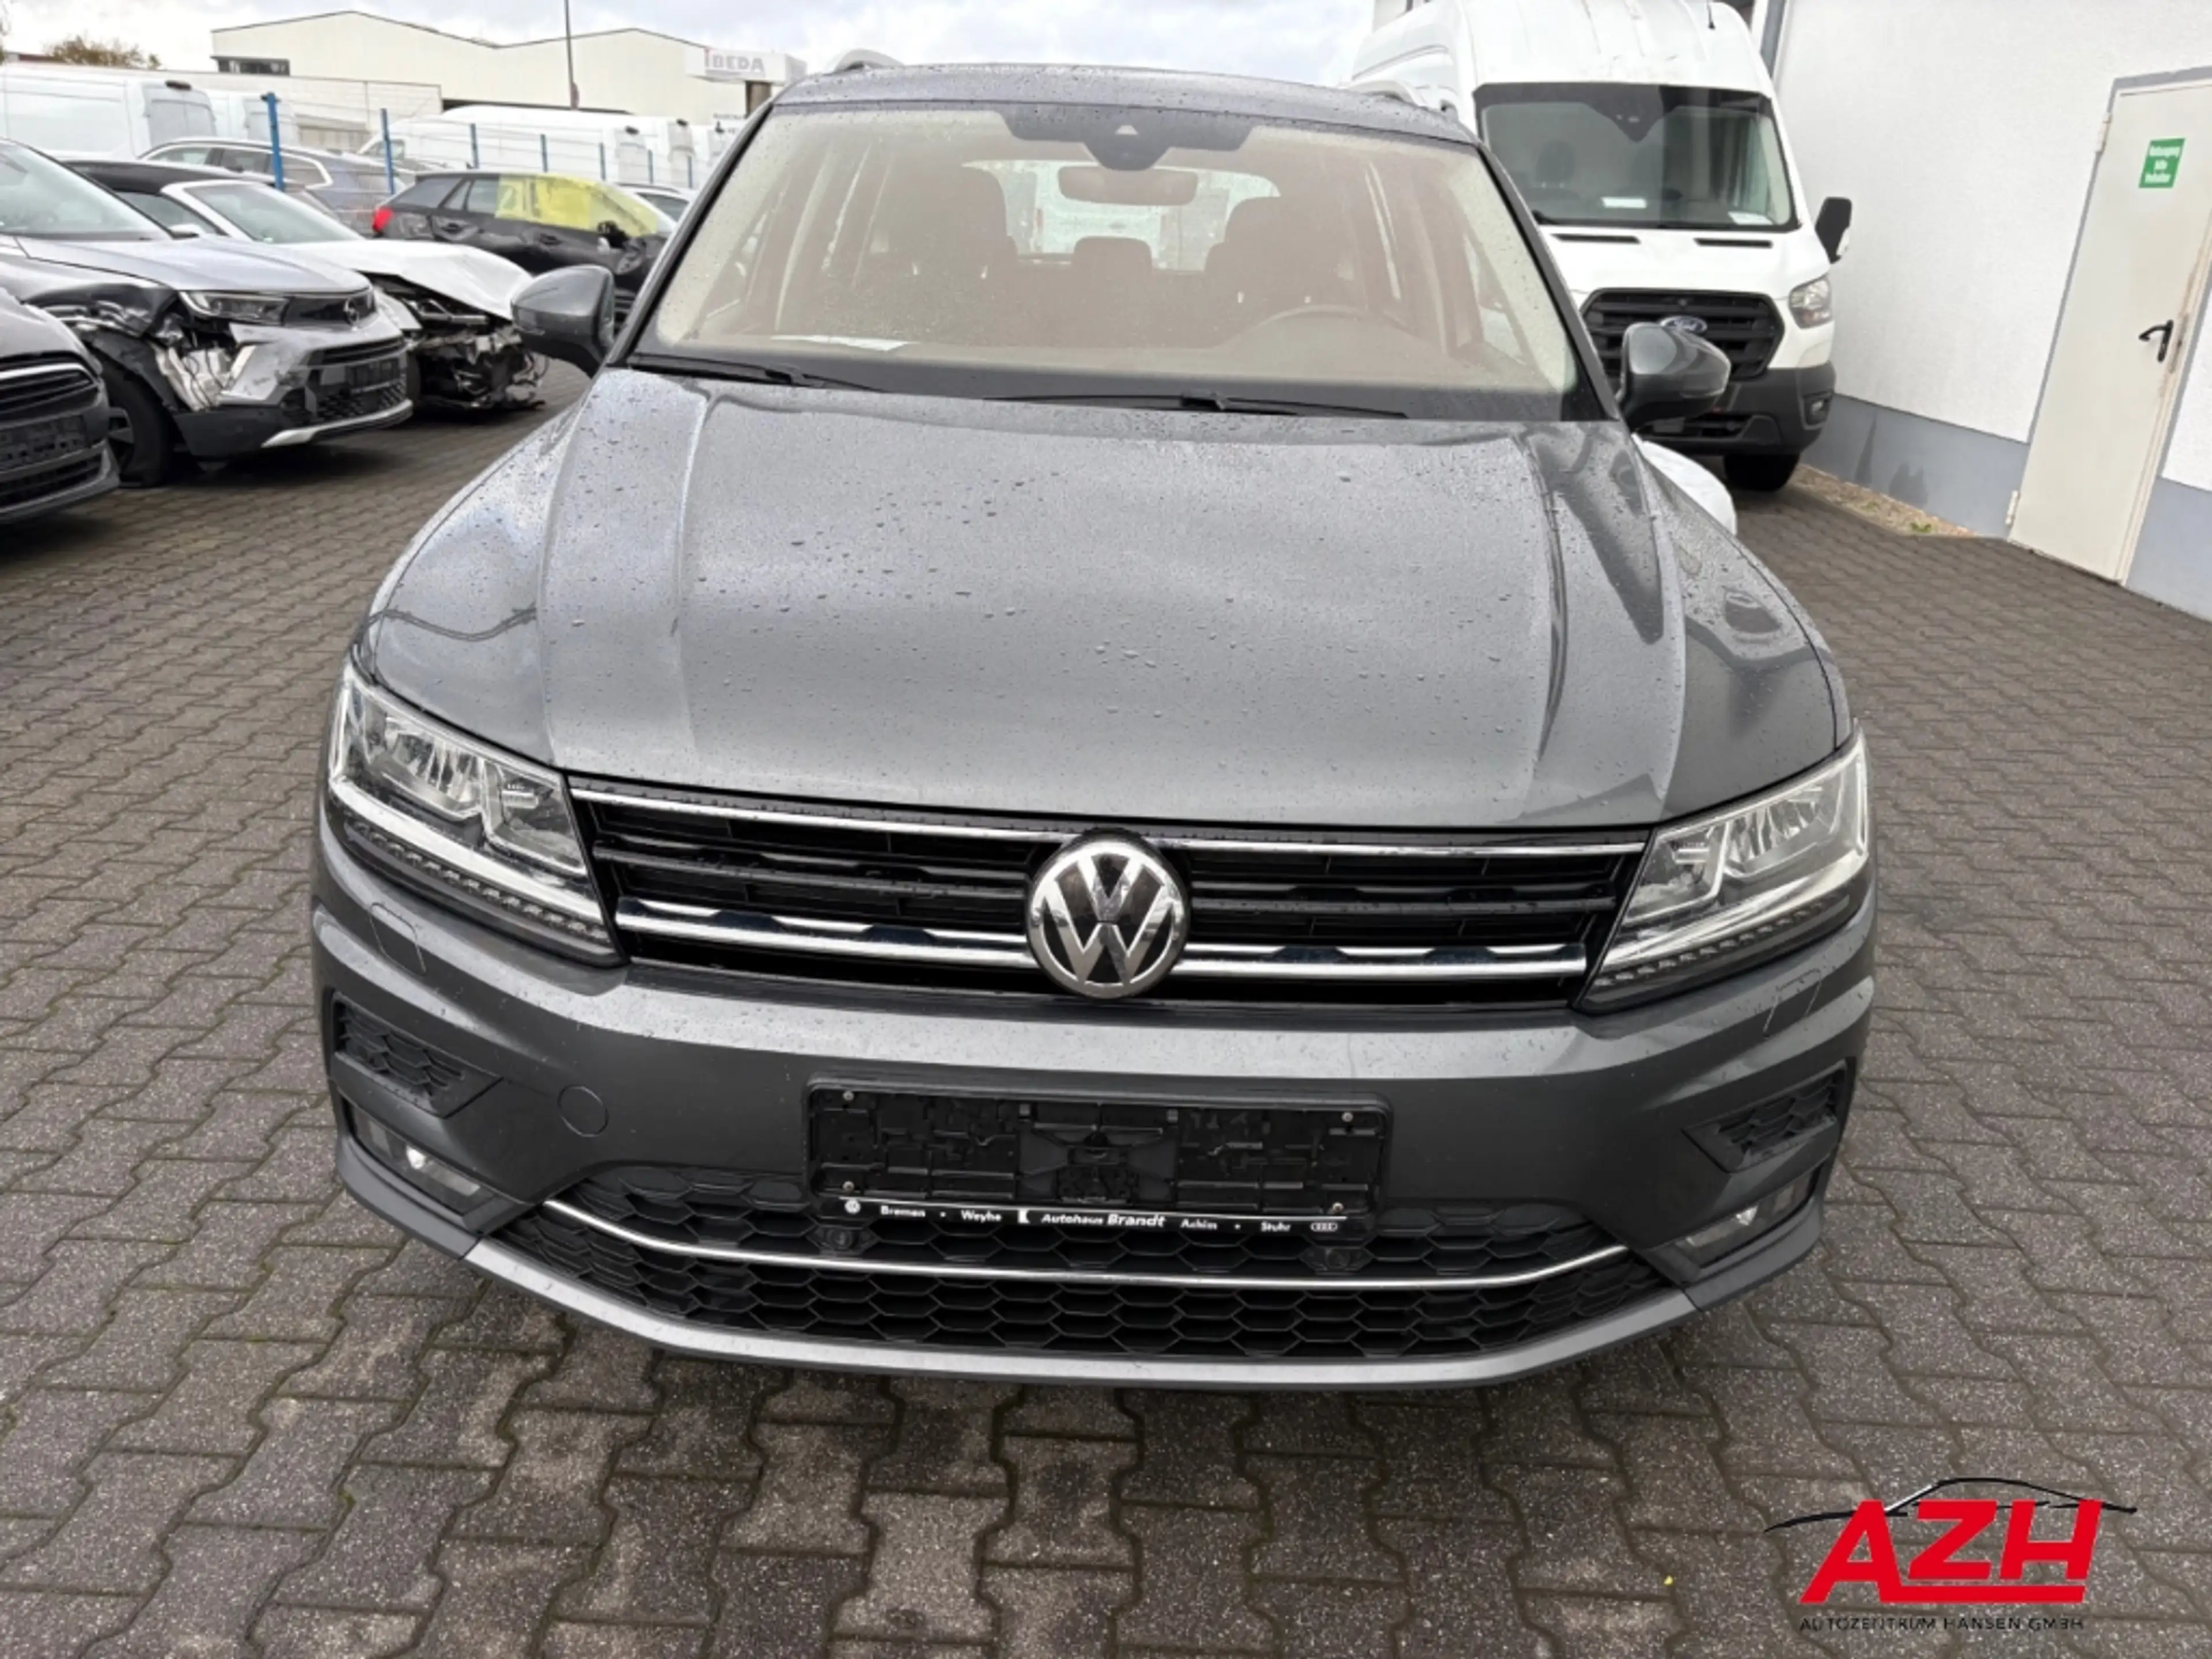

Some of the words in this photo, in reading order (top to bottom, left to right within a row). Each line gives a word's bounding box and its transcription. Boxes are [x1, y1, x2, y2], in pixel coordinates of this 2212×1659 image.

[1034, 846, 1179, 992] VW
[1041, 1214, 1103, 1225] Autohaus
[1107, 1213, 1166, 1228] Brandt
